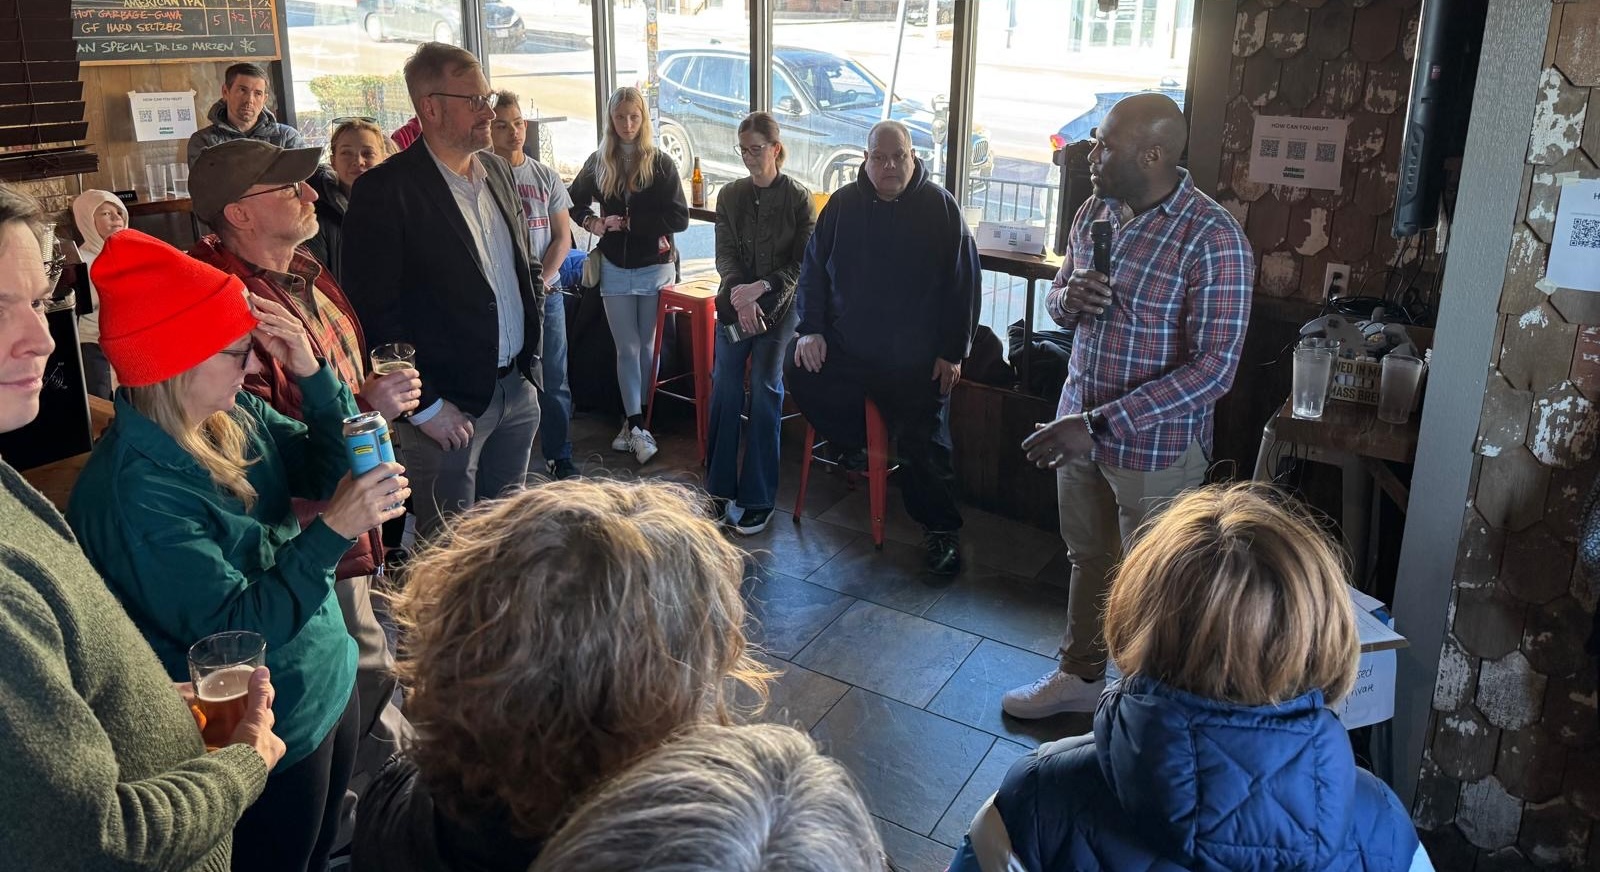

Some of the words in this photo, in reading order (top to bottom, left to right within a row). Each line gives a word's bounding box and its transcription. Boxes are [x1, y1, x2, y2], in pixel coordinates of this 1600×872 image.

[123, 0, 180, 8] AMERICAN
[73, 9, 96, 19] HOT
[81, 22, 101, 34] GF
[106, 23, 132, 33] HARD
[136, 22, 184, 33] SELTZER
[76, 42, 96, 53] AN
[192, 41, 234, 52] MARZEN
[239, 37, 257, 54] $6
[1357, 665, 1373, 679] sed
